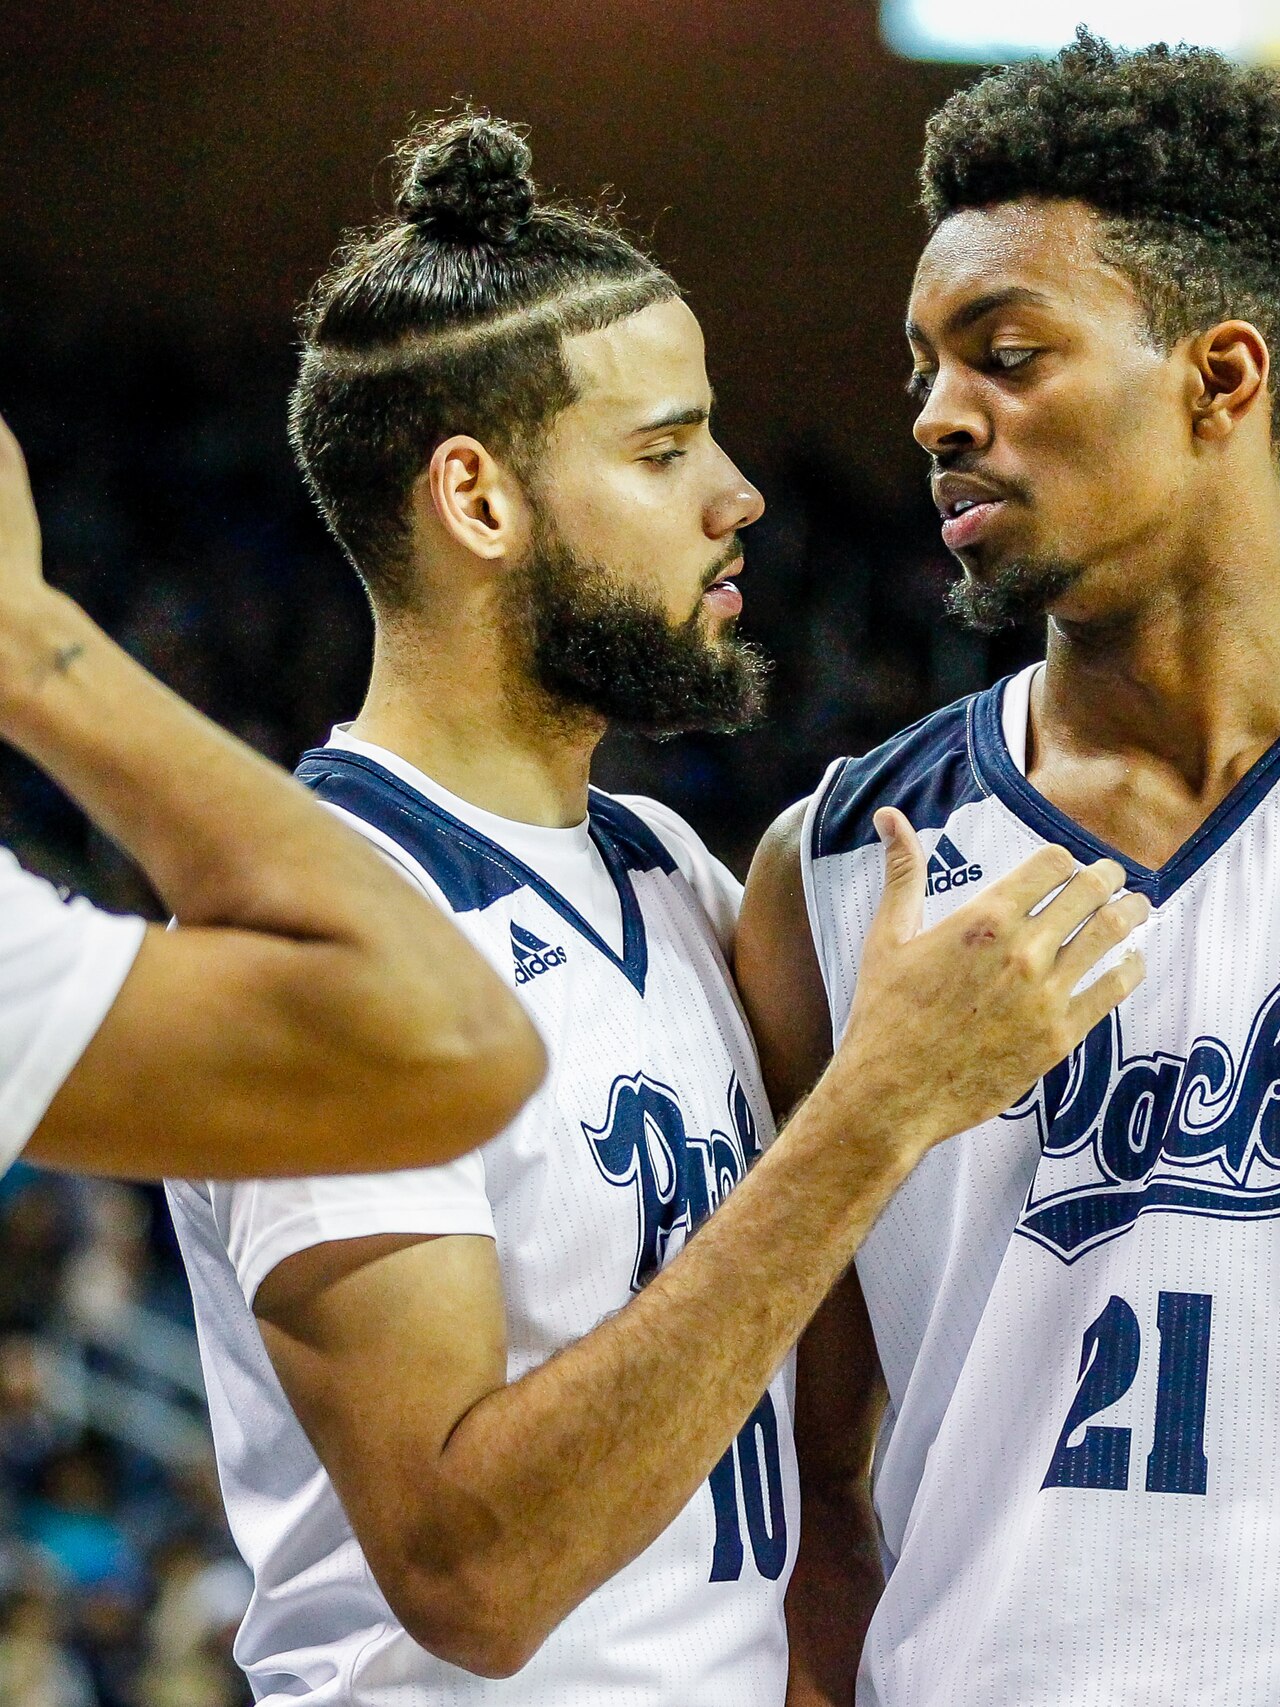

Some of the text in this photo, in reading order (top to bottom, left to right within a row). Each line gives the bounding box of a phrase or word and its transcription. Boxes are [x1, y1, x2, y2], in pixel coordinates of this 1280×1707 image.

[925, 864, 983, 897] idas
[514, 946, 567, 988] didas
[1038, 1291, 1213, 1495] 21
[708, 1388, 787, 1583] 10
